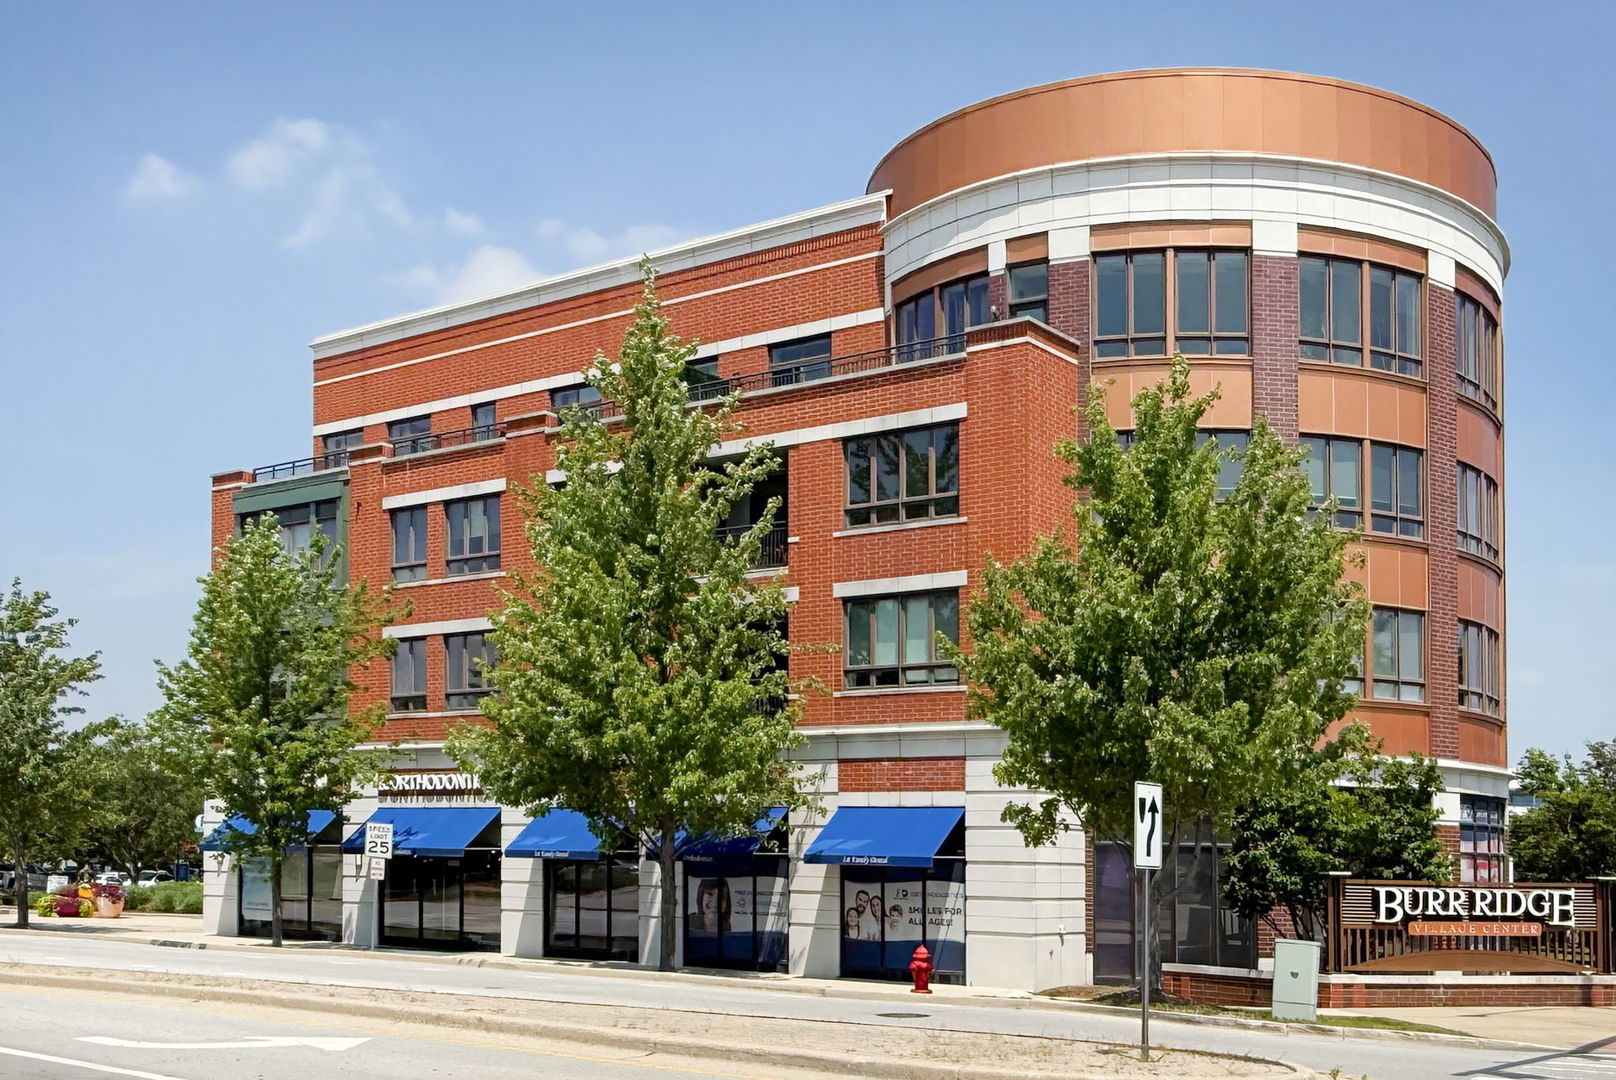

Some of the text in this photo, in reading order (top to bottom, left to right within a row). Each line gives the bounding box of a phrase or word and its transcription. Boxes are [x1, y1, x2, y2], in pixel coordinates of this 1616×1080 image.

[389, 773, 481, 790] ORTHODONTI
[368, 840, 390, 854] 25
[944, 907, 962, 916] FOR
[1374, 886, 1576, 928] BURR RIDGE
[908, 917, 924, 926] ALL
[1414, 923, 1539, 935] VILLAGE CENTER
